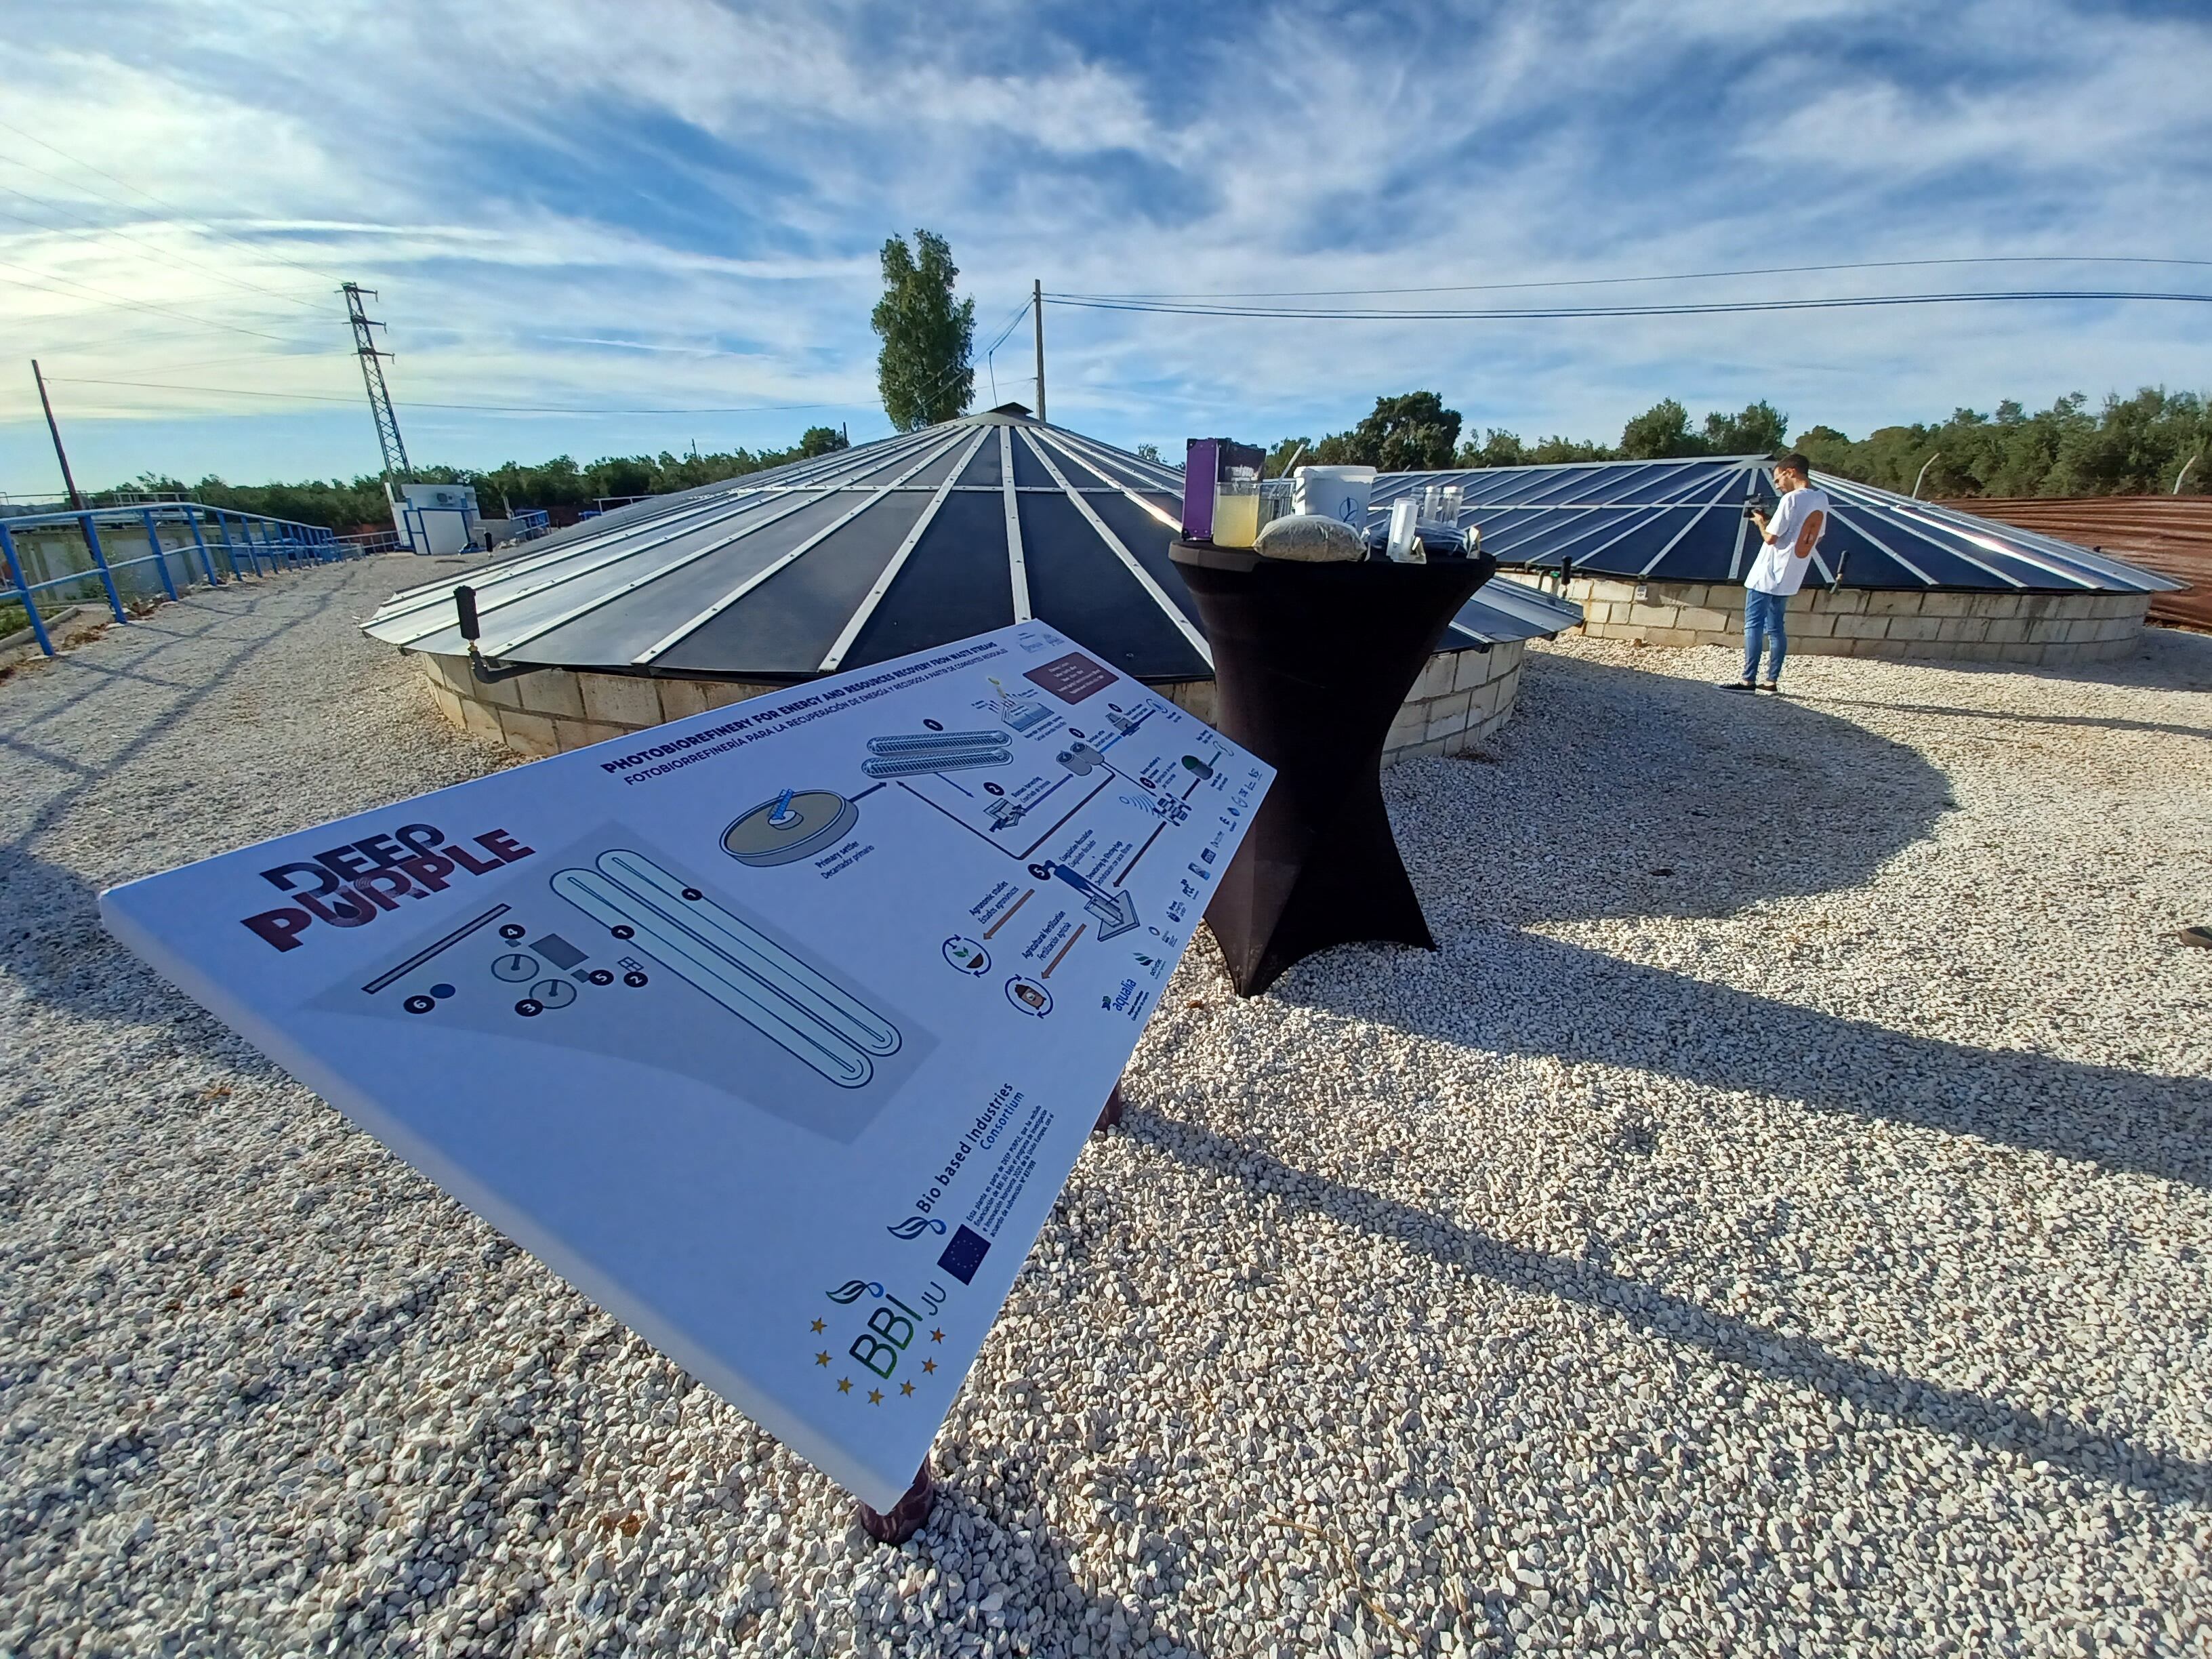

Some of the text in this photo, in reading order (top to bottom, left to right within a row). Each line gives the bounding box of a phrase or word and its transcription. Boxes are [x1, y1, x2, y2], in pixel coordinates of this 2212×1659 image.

[600, 718, 754, 773] PHOTOBIOREFINERY
[751, 708, 782, 724] FOR
[777, 696, 823, 716] ENERGY
[822, 687, 846, 701] AND
[842, 672, 896, 693] RESOURCES
[892, 661, 933, 680] RECOVERY
[623, 738, 748, 785] FOTOBIORREFINERÍA
[745, 726, 775, 742] PARA
[773, 722, 789, 732] LA
[785, 701, 850, 729] RECUPERACIÓN
[847, 696, 861, 706] DE
[240, 829, 536, 952] PURPLE
[259, 823, 445, 899] DEEP
[815, 852, 842, 868] Primary
[969, 881, 1008, 916] Agronomic studies
[1021, 931, 1047, 959] Agricultural
[916, 1083, 1012, 1214] Bio based Industries
[980, 1092, 1025, 1150] Consortium
[966, 1210, 977, 1222] Esta
[975, 1193, 987, 1210] planta
[989, 1172, 1000, 1187] parte
[1001, 1152, 1011, 1165] DEEP
[848, 1281, 947, 1380] BBI JU
